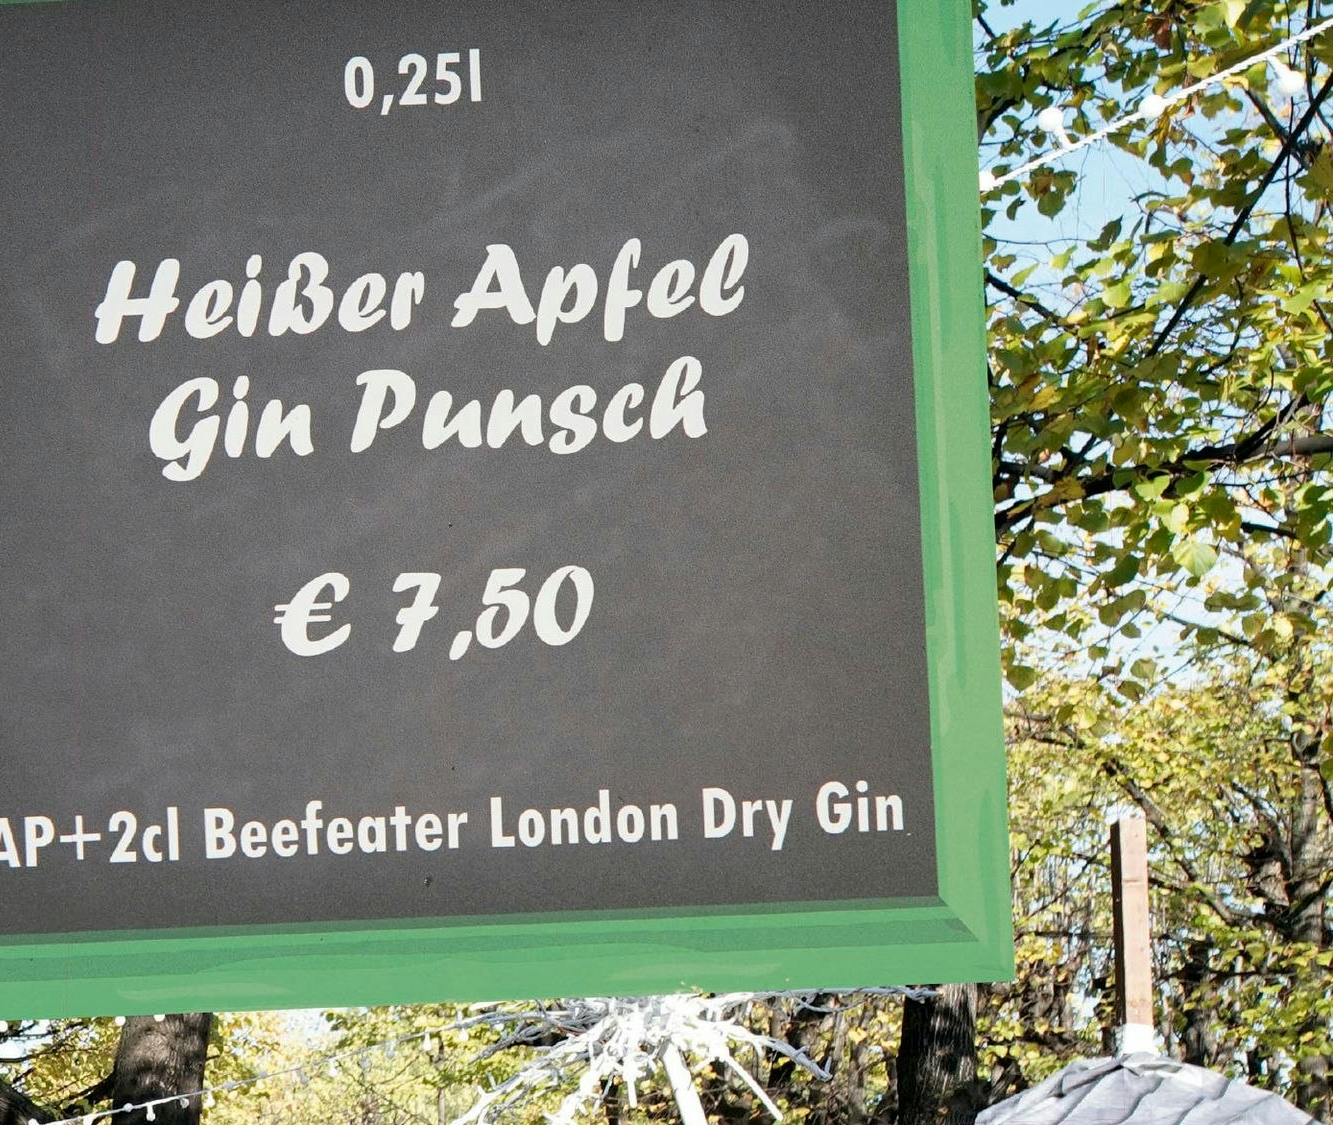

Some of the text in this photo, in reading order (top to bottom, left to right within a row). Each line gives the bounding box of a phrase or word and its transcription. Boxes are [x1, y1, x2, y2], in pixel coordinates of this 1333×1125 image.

[344, 48, 482, 116] 0,25l
[94, 232, 750, 347] Heißer Apfel
[148, 355, 709, 482] Gin Punsch
[272, 564, 595, 661] € 7,50
[203, 806, 469, 861] Beefeater
[489, 788, 679, 848] London
[701, 787, 794, 851] Dry
[815, 779, 905, 834] Gin
